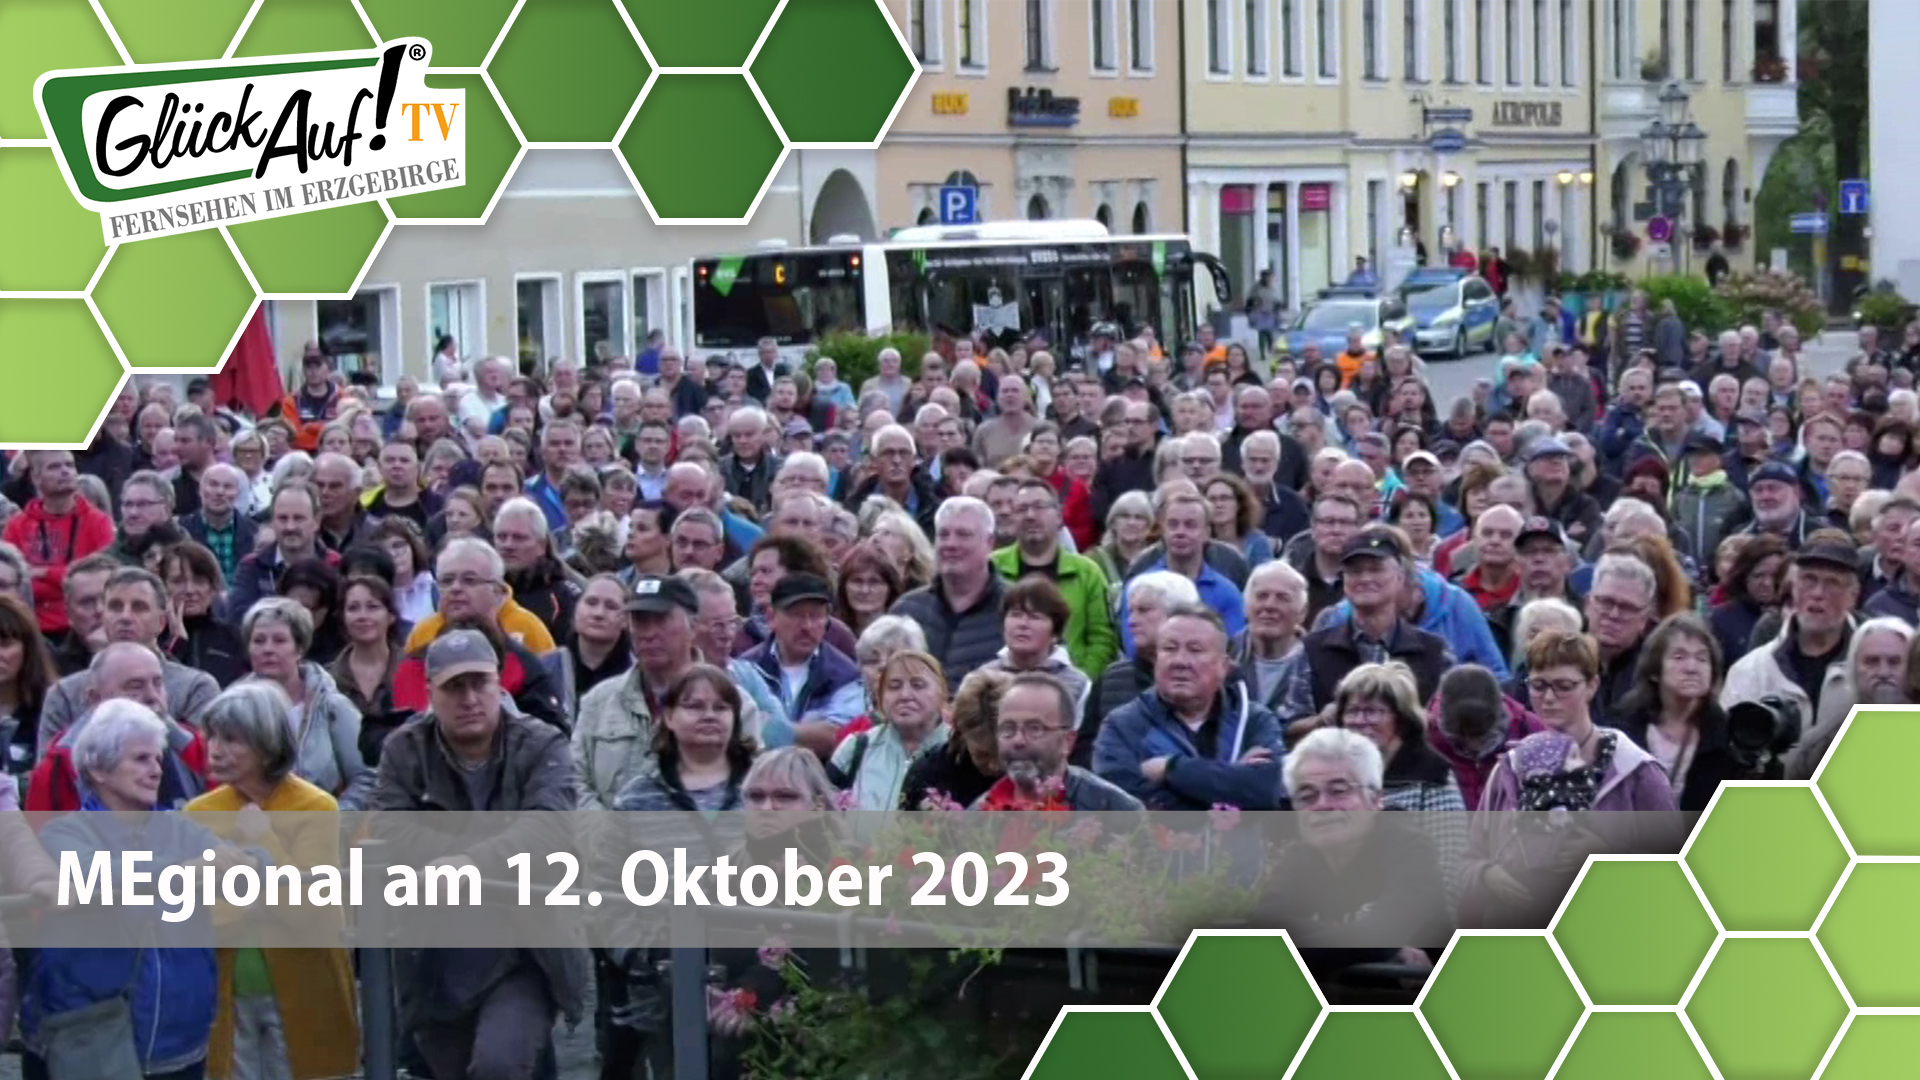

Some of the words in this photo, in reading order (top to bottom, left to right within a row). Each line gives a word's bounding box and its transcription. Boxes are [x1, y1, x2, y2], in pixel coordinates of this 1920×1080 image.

[1491, 100, 1563, 127] AKROPOLIS
[947, 191, 967, 222] P
[775, 265, 785, 284] C
